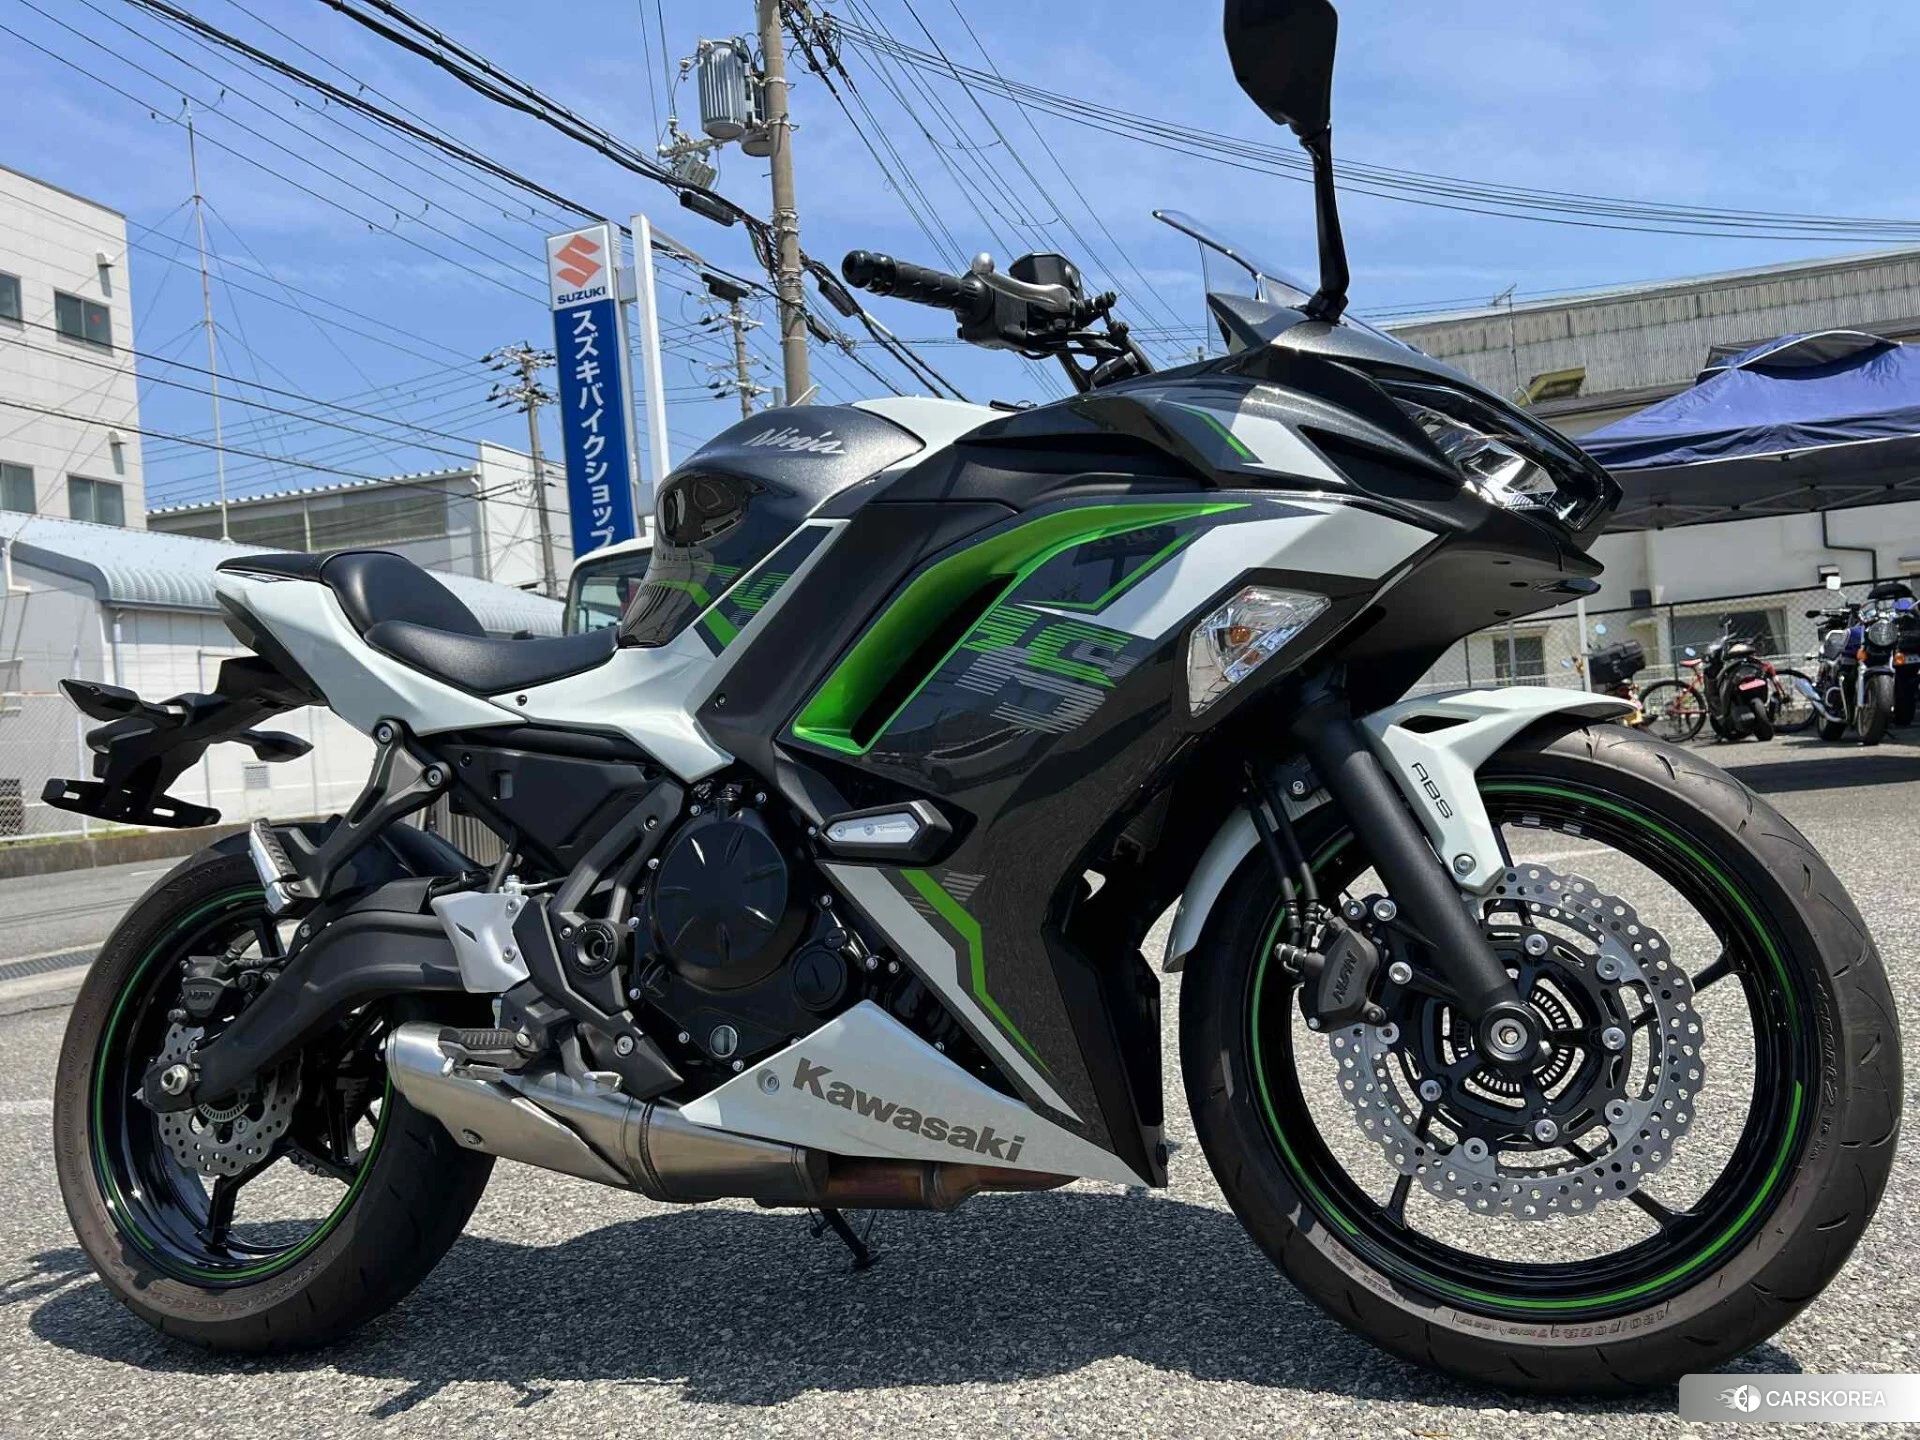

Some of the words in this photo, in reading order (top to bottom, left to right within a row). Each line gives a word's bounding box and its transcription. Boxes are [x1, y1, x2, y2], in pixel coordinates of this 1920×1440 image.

[557, 285, 606, 305] SUZUKI
[571, 309, 615, 550] スズキバイクショップ
[741, 426, 847, 455] Ninja
[1411, 761, 1453, 819] ABS
[792, 1056, 1026, 1163] Kawasaki
